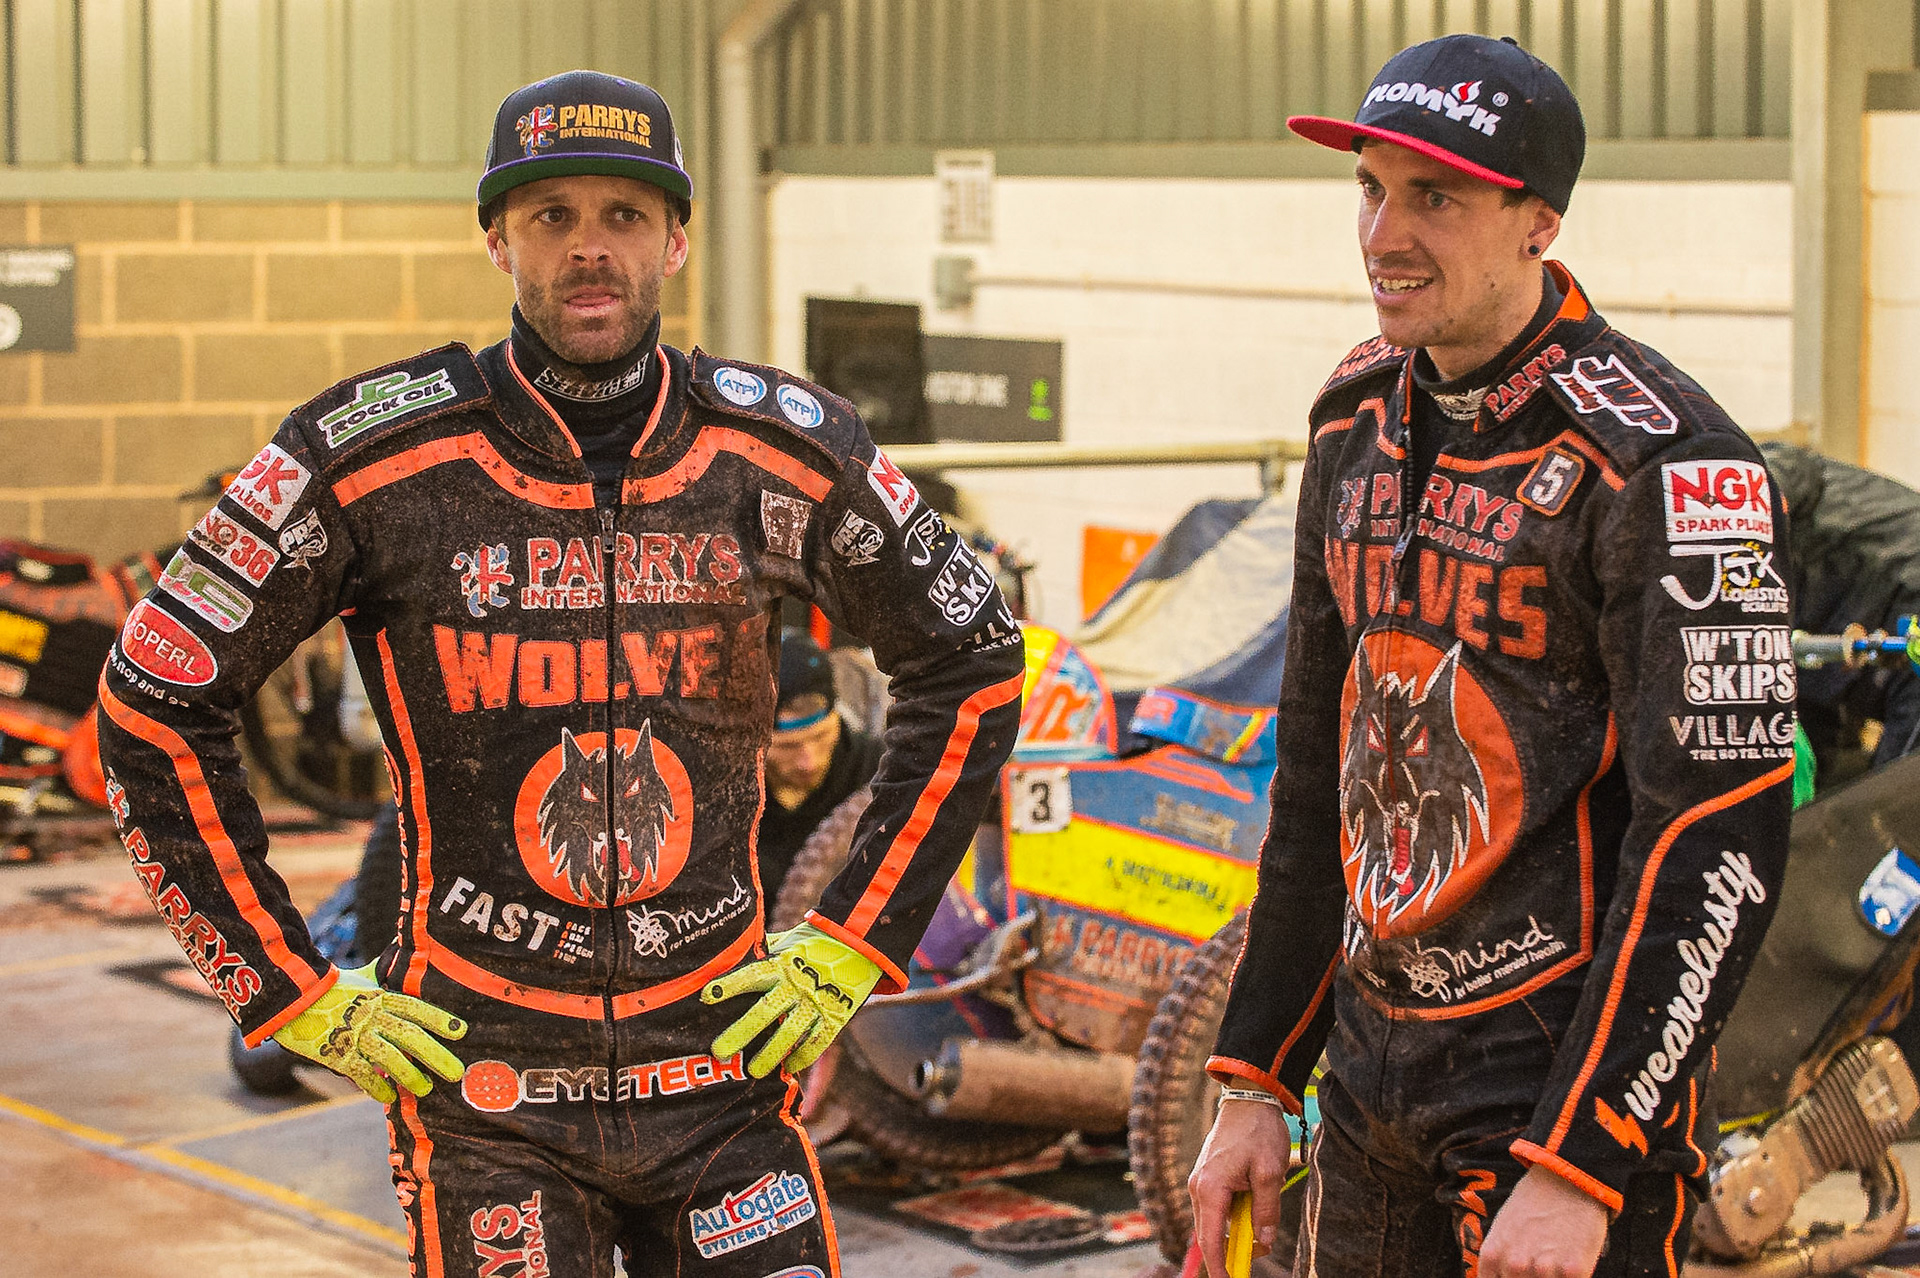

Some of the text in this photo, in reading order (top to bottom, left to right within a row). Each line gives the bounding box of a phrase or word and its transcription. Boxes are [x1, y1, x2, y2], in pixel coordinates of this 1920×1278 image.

[559, 104, 652, 136] PARRYS
[559, 127, 653, 149] INTERNATIONAL
[722, 378, 757, 396] ATPI
[1485, 344, 1567, 413] PARRYS
[1578, 360, 1673, 431] JWP
[330, 382, 446, 436] ROCK OIL
[783, 396, 815, 420] ATPI
[1530, 454, 1574, 506] 5
[1670, 467, 1769, 514] NGK
[229, 484, 273, 522] PLUGS
[1675, 518, 1731, 533] SPARK
[527, 531, 744, 588] PARRYS
[1370, 518, 1505, 562] INTNATIONAL
[520, 579, 749, 609] INTERNATIONAL
[931, 540, 975, 603] W'T
[1324, 532, 1548, 660] WOVES
[128, 614, 196, 676] OPERL
[1688, 630, 1792, 662] W'TON
[137, 679, 166, 700] and
[432, 622, 770, 714] WOLVE
[1688, 662, 1797, 700] SKIPS
[1668, 711, 1798, 746] VILLAG
[1690, 749, 1718, 761] THE
[1030, 783, 1052, 825] 3
[124, 827, 263, 1006] PARRYS
[439, 876, 560, 951] FAST
[669, 940, 684, 952] for
[1451, 914, 1555, 978] mind
[521, 1051, 748, 1103] EYETECH
[692, 1175, 806, 1239] Autogate
[471, 1204, 527, 1278] YS
[702, 1224, 767, 1256] SYSTEMS
